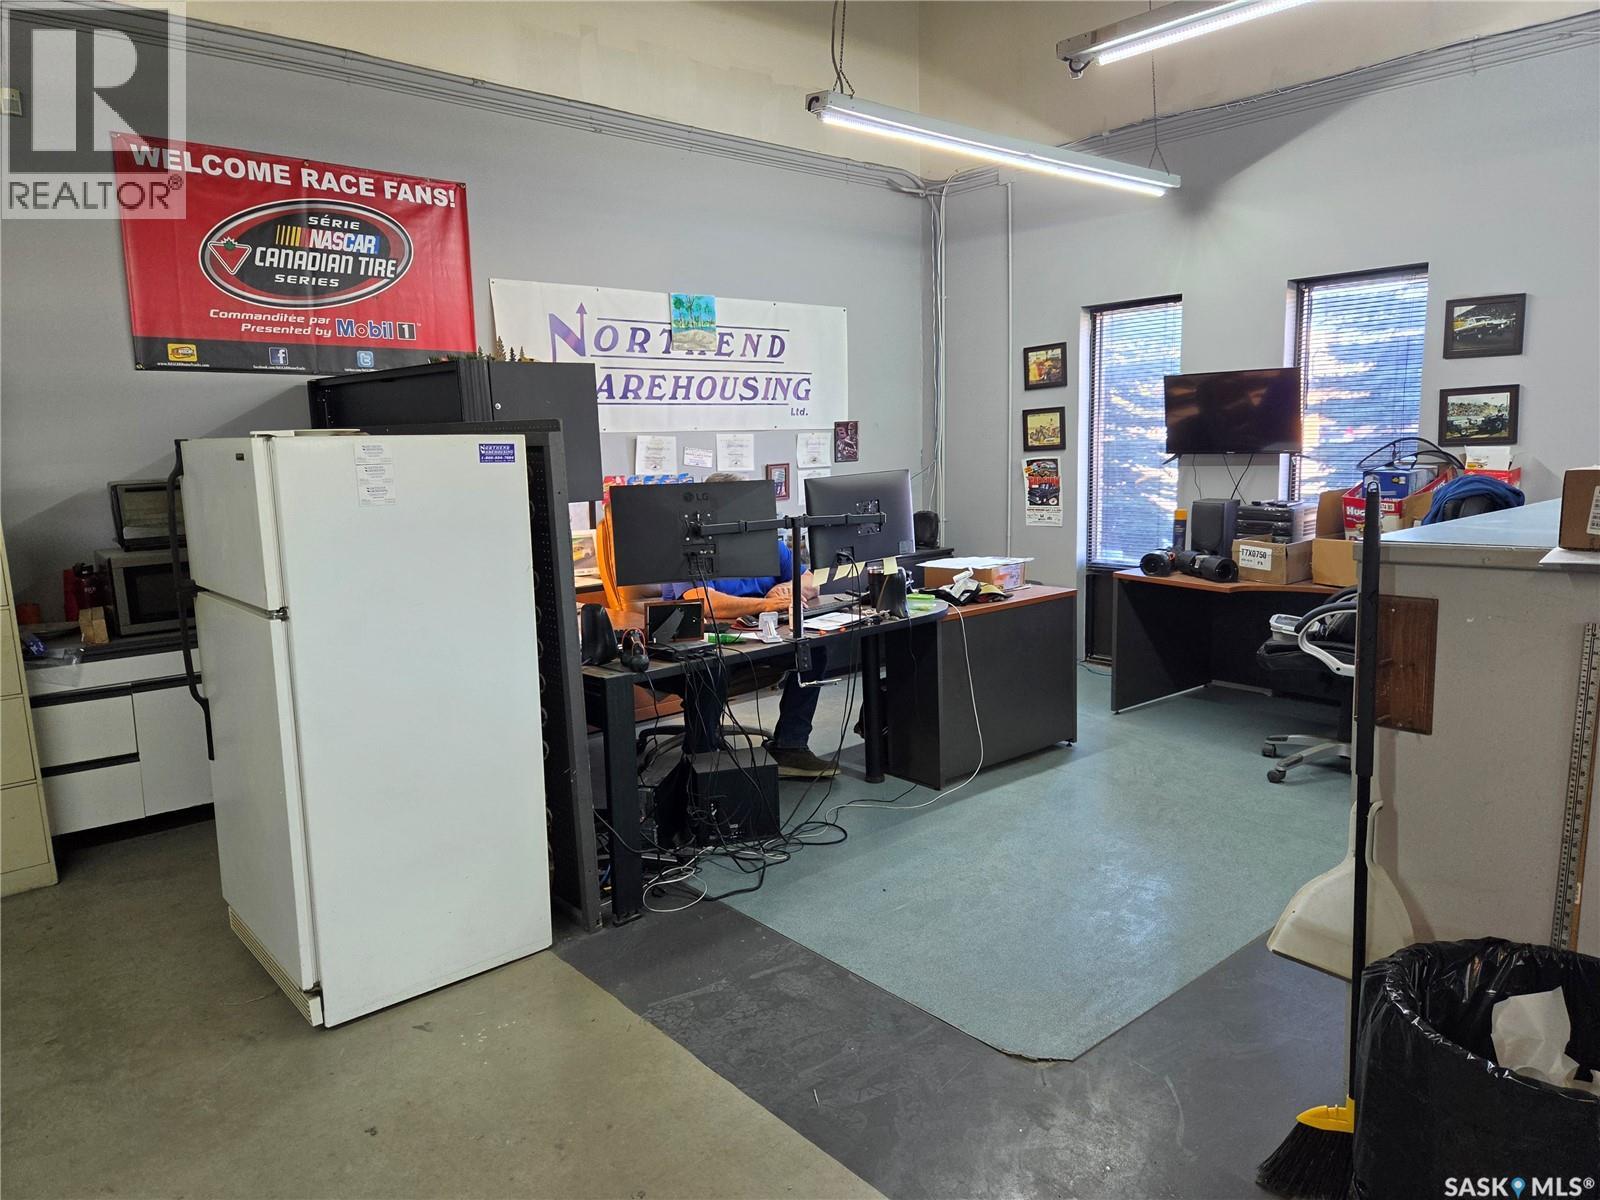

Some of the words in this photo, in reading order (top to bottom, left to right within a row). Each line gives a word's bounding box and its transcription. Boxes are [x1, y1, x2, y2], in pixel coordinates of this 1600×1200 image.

[130, 143, 292, 186] WELCOME
[300, 167, 376, 198] RACE
[383, 180, 456, 208] FANS!
[308, 214, 361, 231] SÉRIE
[309, 228, 378, 254] NASCAR
[254, 246, 353, 275] CANADIAN
[358, 256, 398, 279] TIRE
[274, 273, 340, 288] SERIES
[209, 308, 305, 324] Commanditée
[309, 316, 331, 326] par
[240, 322, 311, 336] Presented
[315, 327, 332, 338] by
[335, 317, 394, 340] Mobil
[548, 303, 787, 363] NORTEND
[597, 373, 812, 402] AREHOUSING
[790, 406, 809, 417] Ltd.
[695, 493, 710, 501] LG
